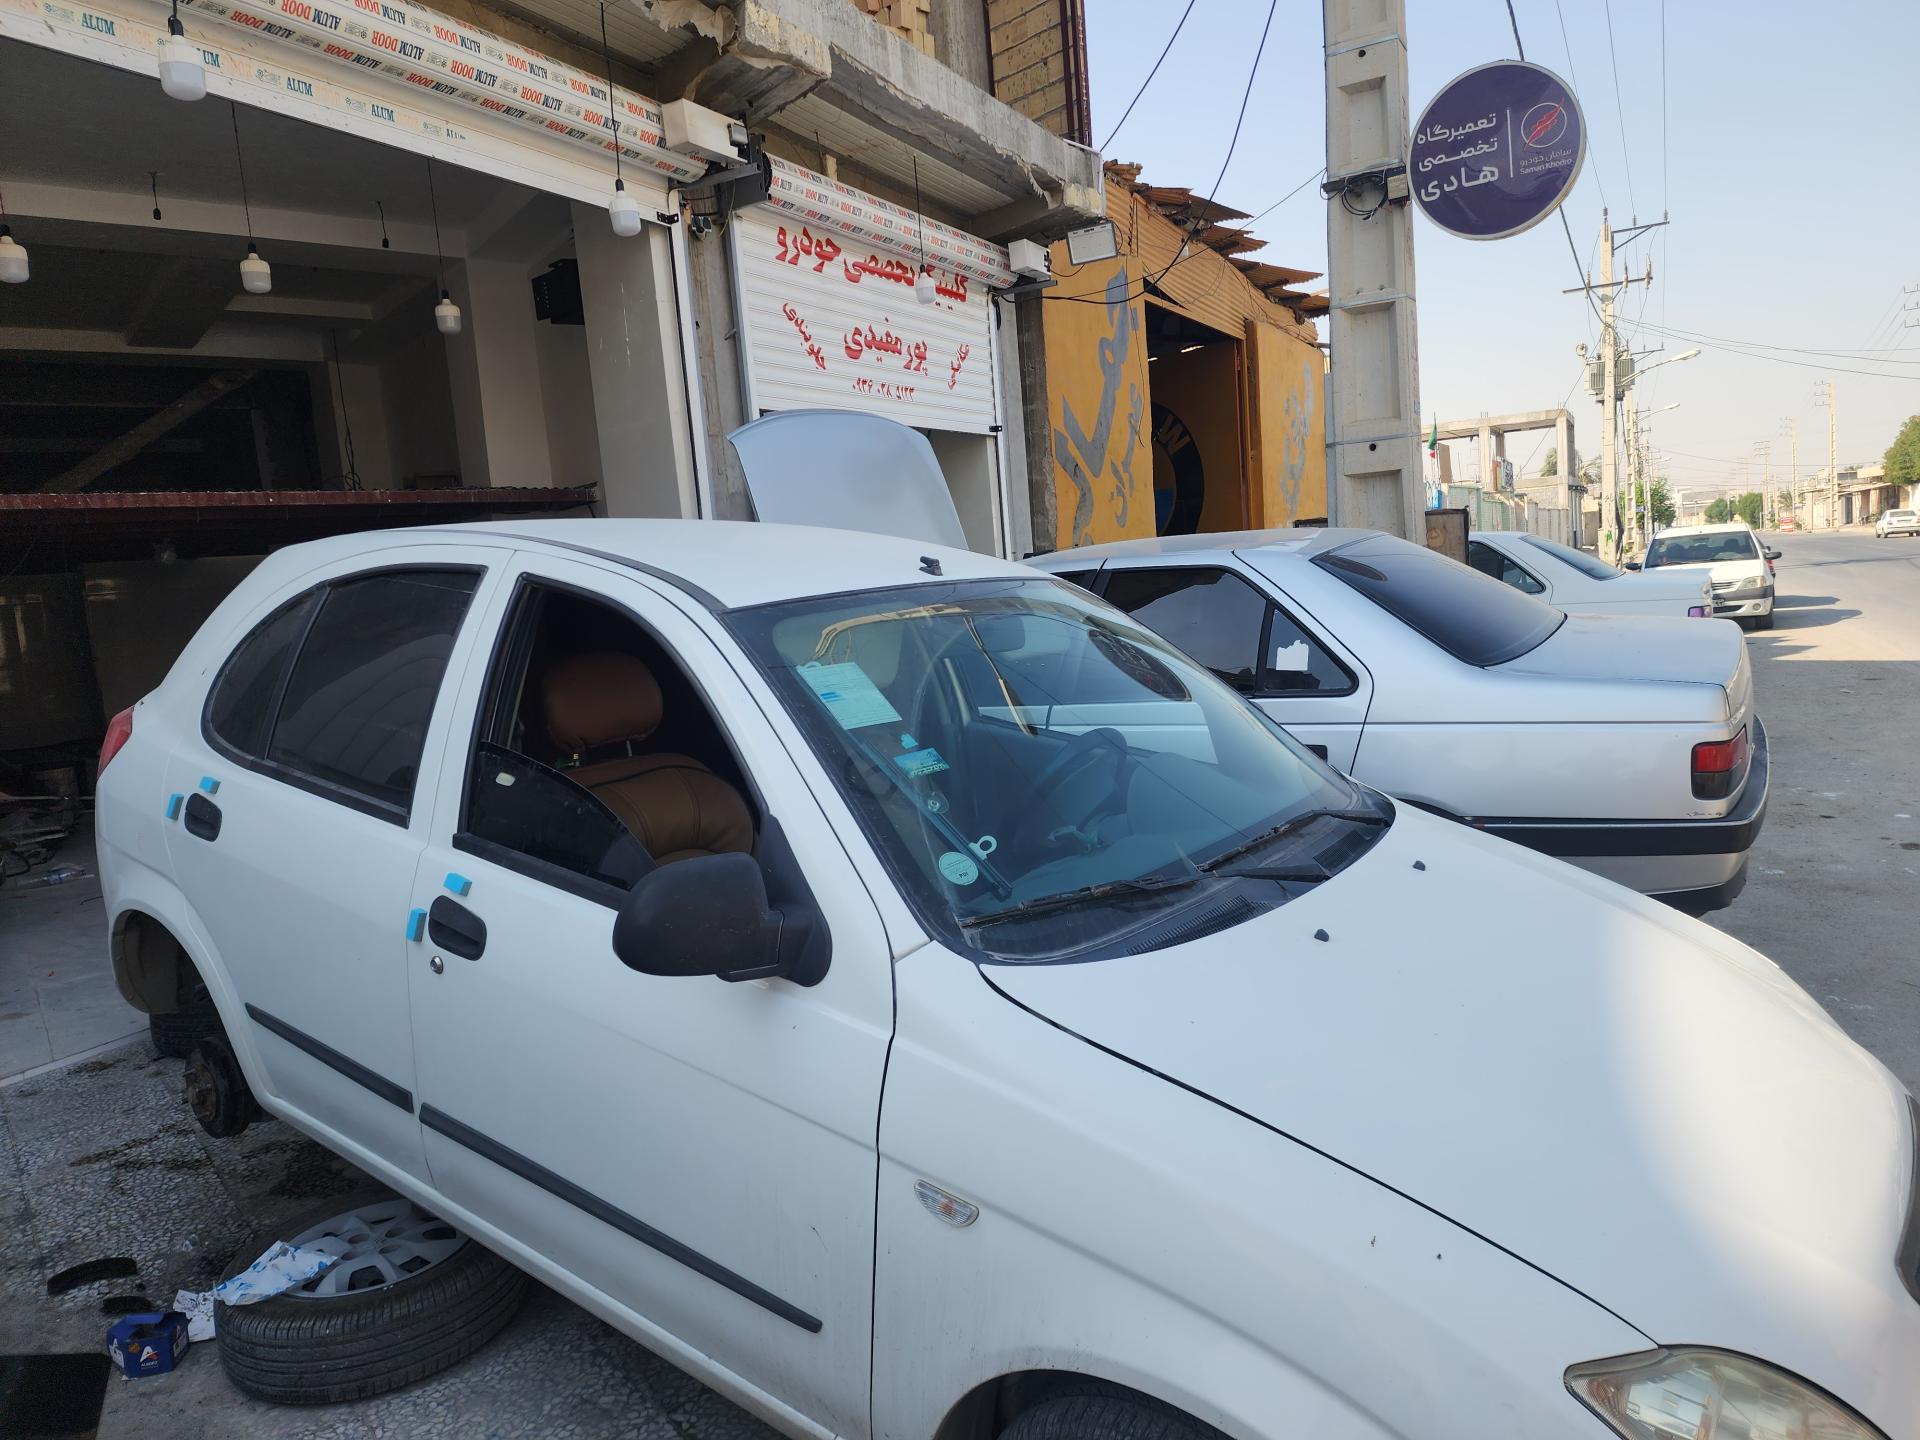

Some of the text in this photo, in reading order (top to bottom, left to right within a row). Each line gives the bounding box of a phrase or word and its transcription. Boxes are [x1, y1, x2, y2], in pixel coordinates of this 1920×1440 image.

[281, 0, 312, 20] DOOR
[312, 8, 342, 31] ALUM
[81, 12, 115, 36] ALUM
[230, 10, 296, 39] ALUM DOOR
[371, 30, 398, 52] DOOR
[398, 40, 425, 61] ALUM
[323, 43, 382, 69] ALUM DOOR
[450, 59, 475, 80] DOOR
[474, 68, 498, 88] ALUM
[286, 76, 313, 97] ALUM
[405, 73, 459, 96] ALUM DOOR
[520, 86, 543, 105] DOOR
[371, 103, 395, 122] ALUM
[541, 94, 563, 112] ALUM
[1416, 113, 1497, 145] تعمیرگاه
[1418, 137, 1498, 172] تخصصی
[1420, 165, 1499, 202] هادی
